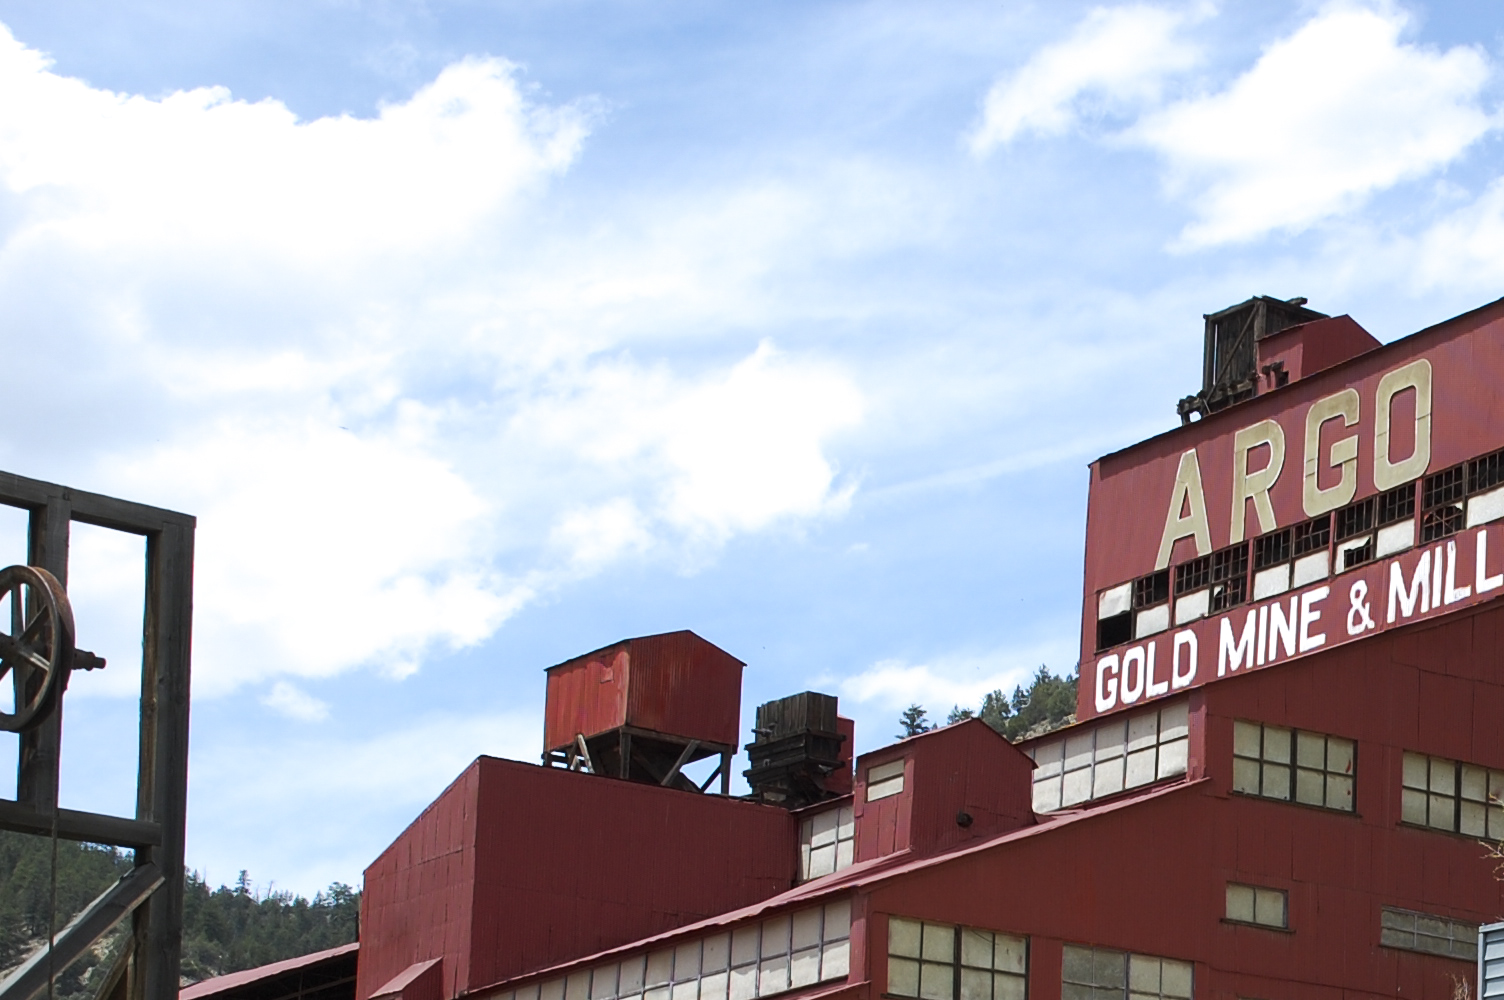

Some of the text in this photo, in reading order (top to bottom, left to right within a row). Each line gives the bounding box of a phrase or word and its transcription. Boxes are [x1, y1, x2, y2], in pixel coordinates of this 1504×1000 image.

[1154, 358, 1432, 571] ARGO
[1094, 529, 1504, 713] GOLD MINE & MILL
